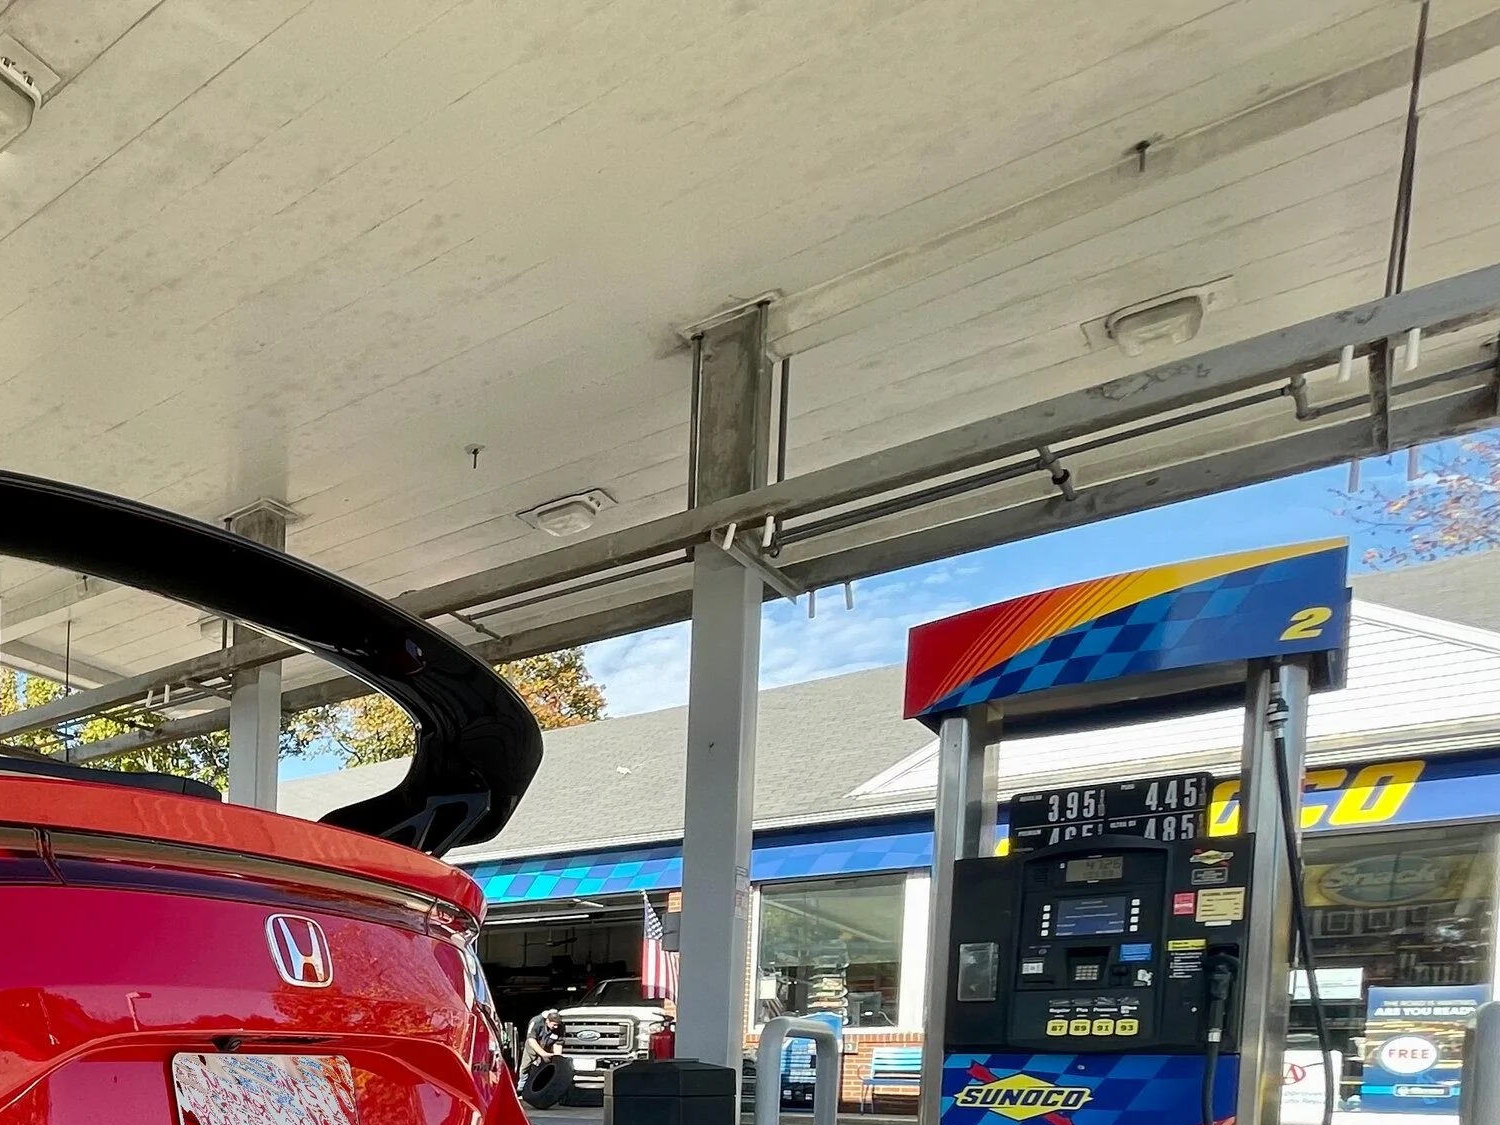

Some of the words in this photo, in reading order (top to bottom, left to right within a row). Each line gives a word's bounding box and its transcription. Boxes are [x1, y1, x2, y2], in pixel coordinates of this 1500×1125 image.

[1279, 606, 1333, 642] 2
[1048, 790, 1096, 823] 3.95
[1145, 778, 1198, 811] 4.45
[1402, 1007, 1432, 1016] YOU
[1388, 1049, 1430, 1059] FREE
[960, 1087, 1085, 1108] SUNOCO
